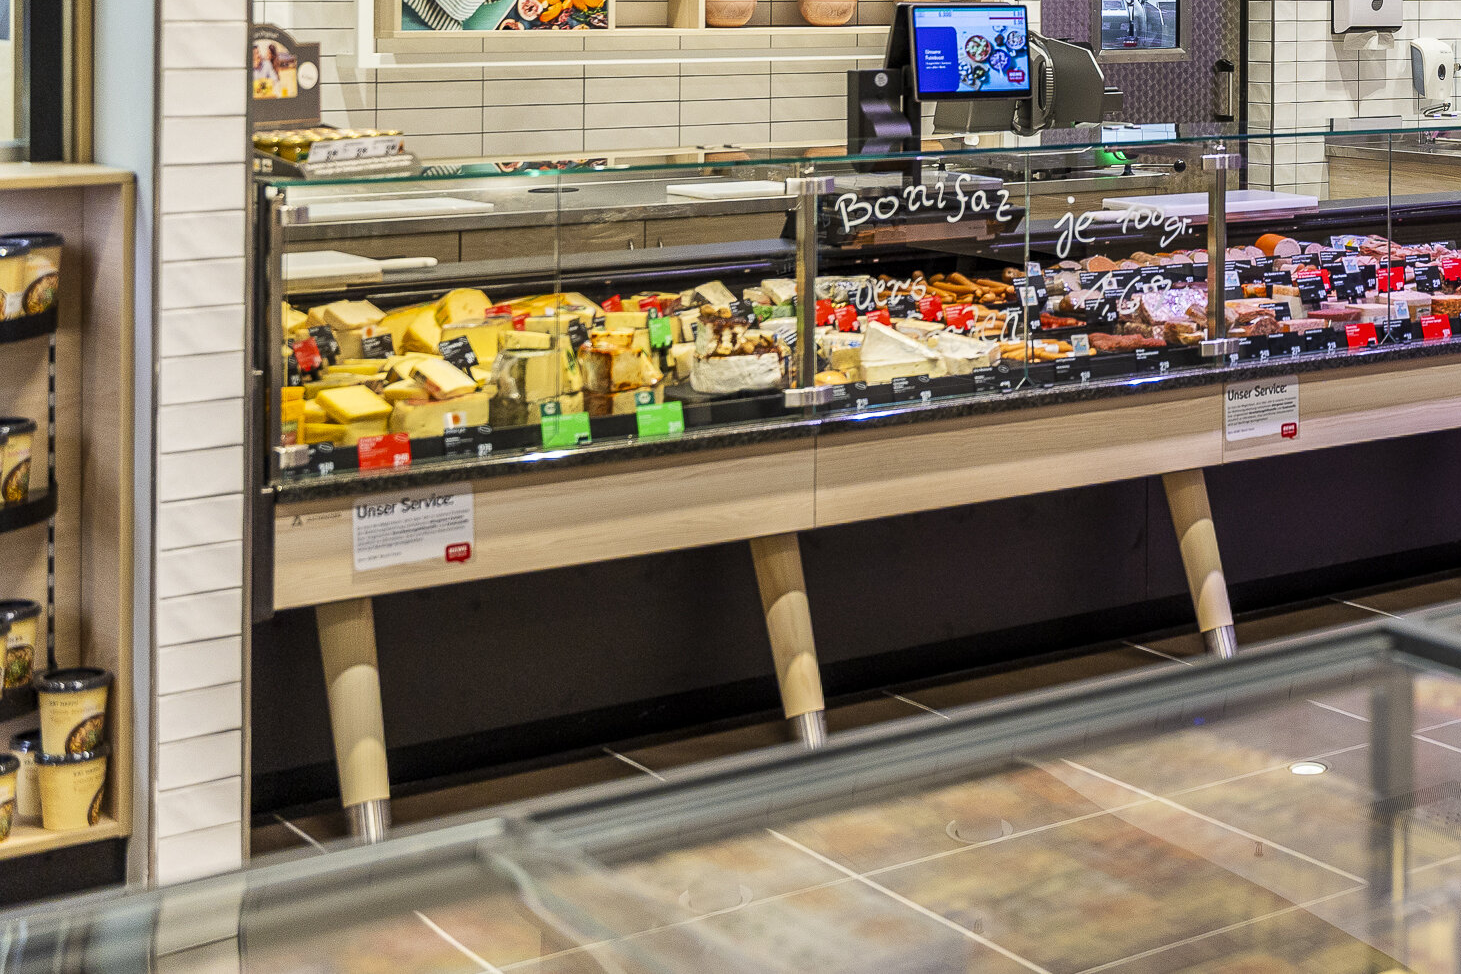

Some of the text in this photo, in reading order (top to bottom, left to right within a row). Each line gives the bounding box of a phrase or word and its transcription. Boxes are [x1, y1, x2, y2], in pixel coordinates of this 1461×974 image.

[834, 173, 1013, 234] Bonifaz
[1053, 196, 1096, 259] je
[1227, 389, 1252, 402] Unser
[356, 501, 396, 520] Unser
